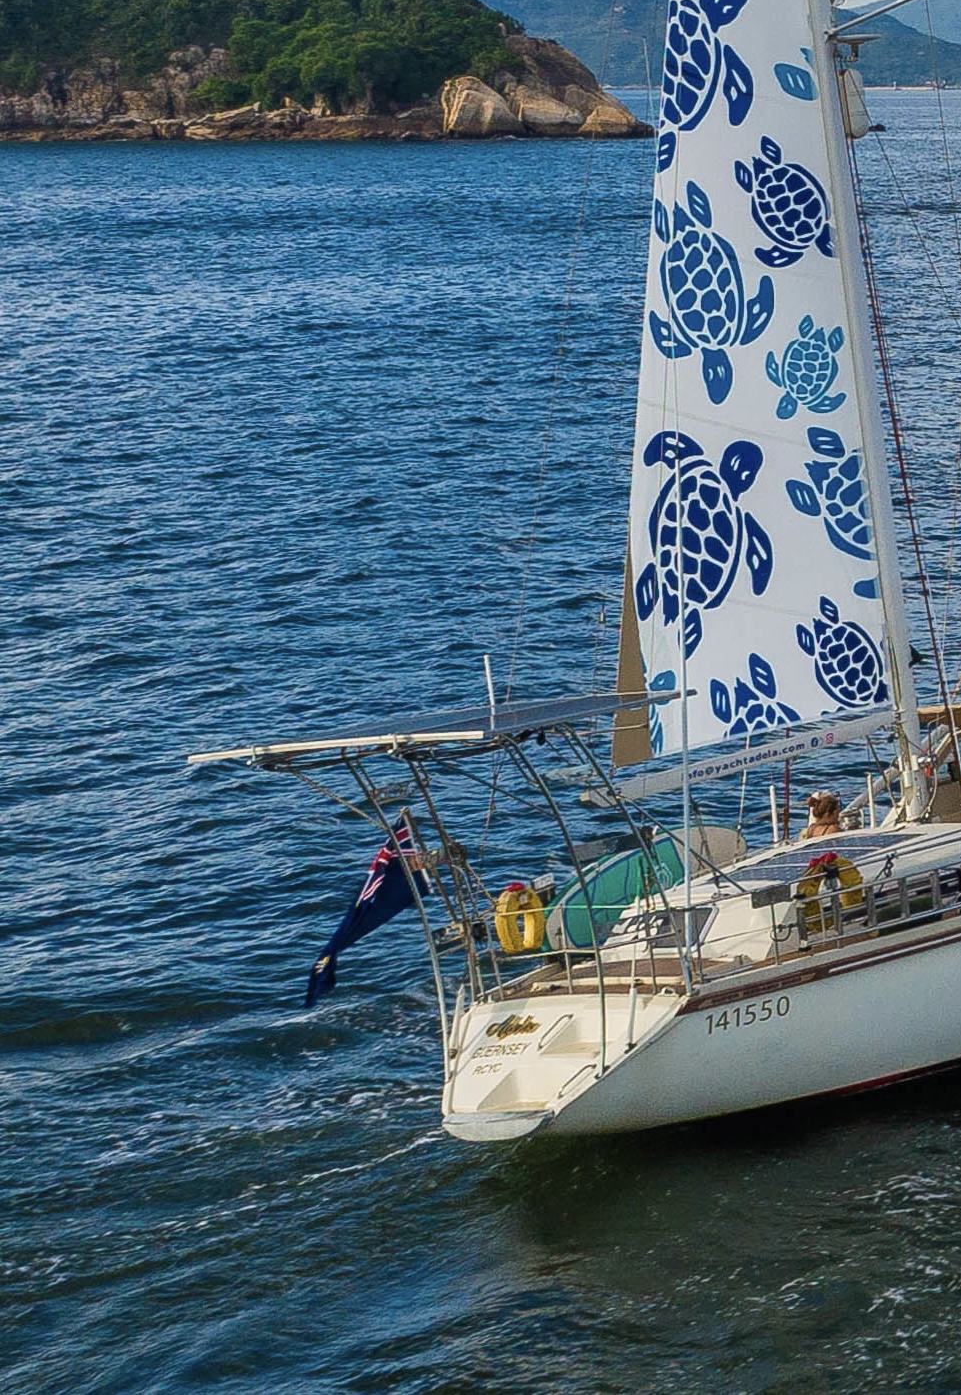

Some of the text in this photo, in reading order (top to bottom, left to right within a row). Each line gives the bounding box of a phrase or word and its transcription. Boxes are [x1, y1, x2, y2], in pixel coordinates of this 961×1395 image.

[682, 743, 805, 781] nfo@yachtadela.com
[705, 996, 790, 1035] 141550
[472, 1042, 532, 1059] GUERNSEY
